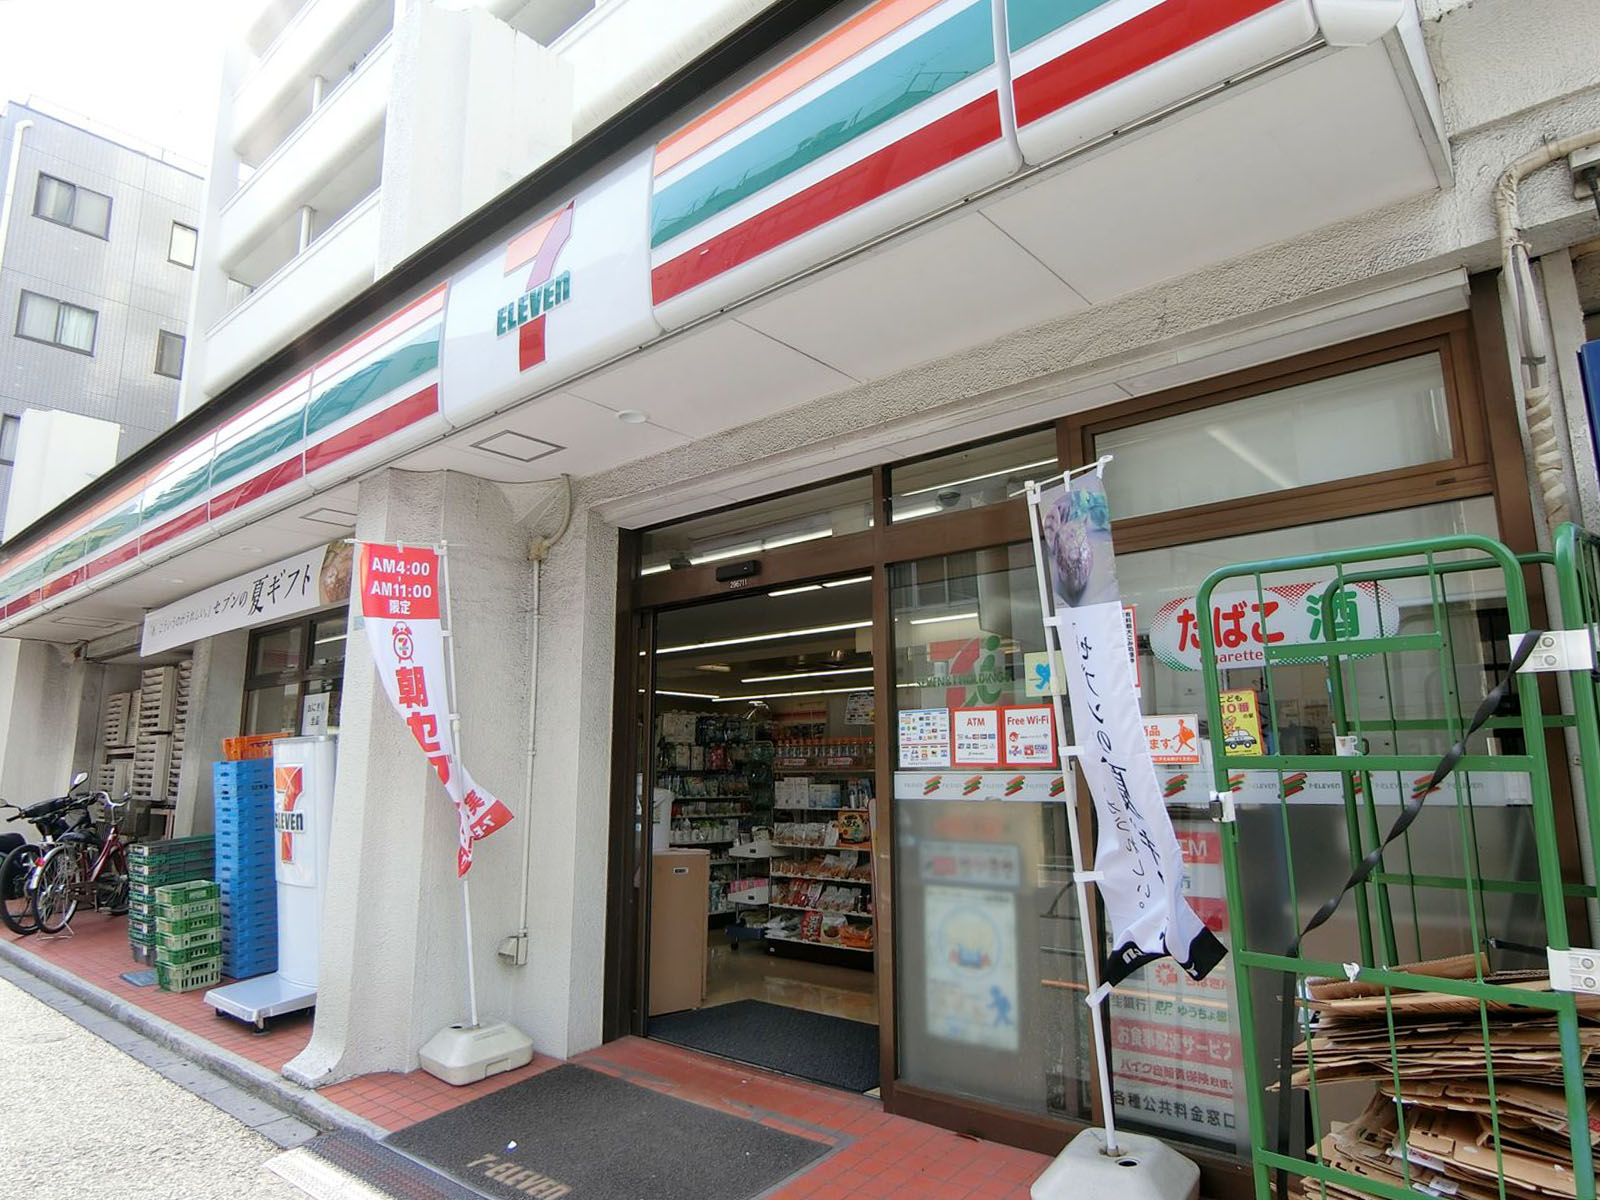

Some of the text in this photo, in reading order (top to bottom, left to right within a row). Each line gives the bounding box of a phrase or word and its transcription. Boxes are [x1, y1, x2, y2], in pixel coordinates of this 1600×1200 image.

[372, 557, 430, 576] AM4:00
[213, 564, 311, 615] セブンの夏ギフト
[370, 581, 432, 598] AM11:00
[388, 599, 411, 614] 限定
[966, 717, 985, 727] ATM
[1007, 716, 1025, 726] Free
[1177, 838, 1208, 857] TM
